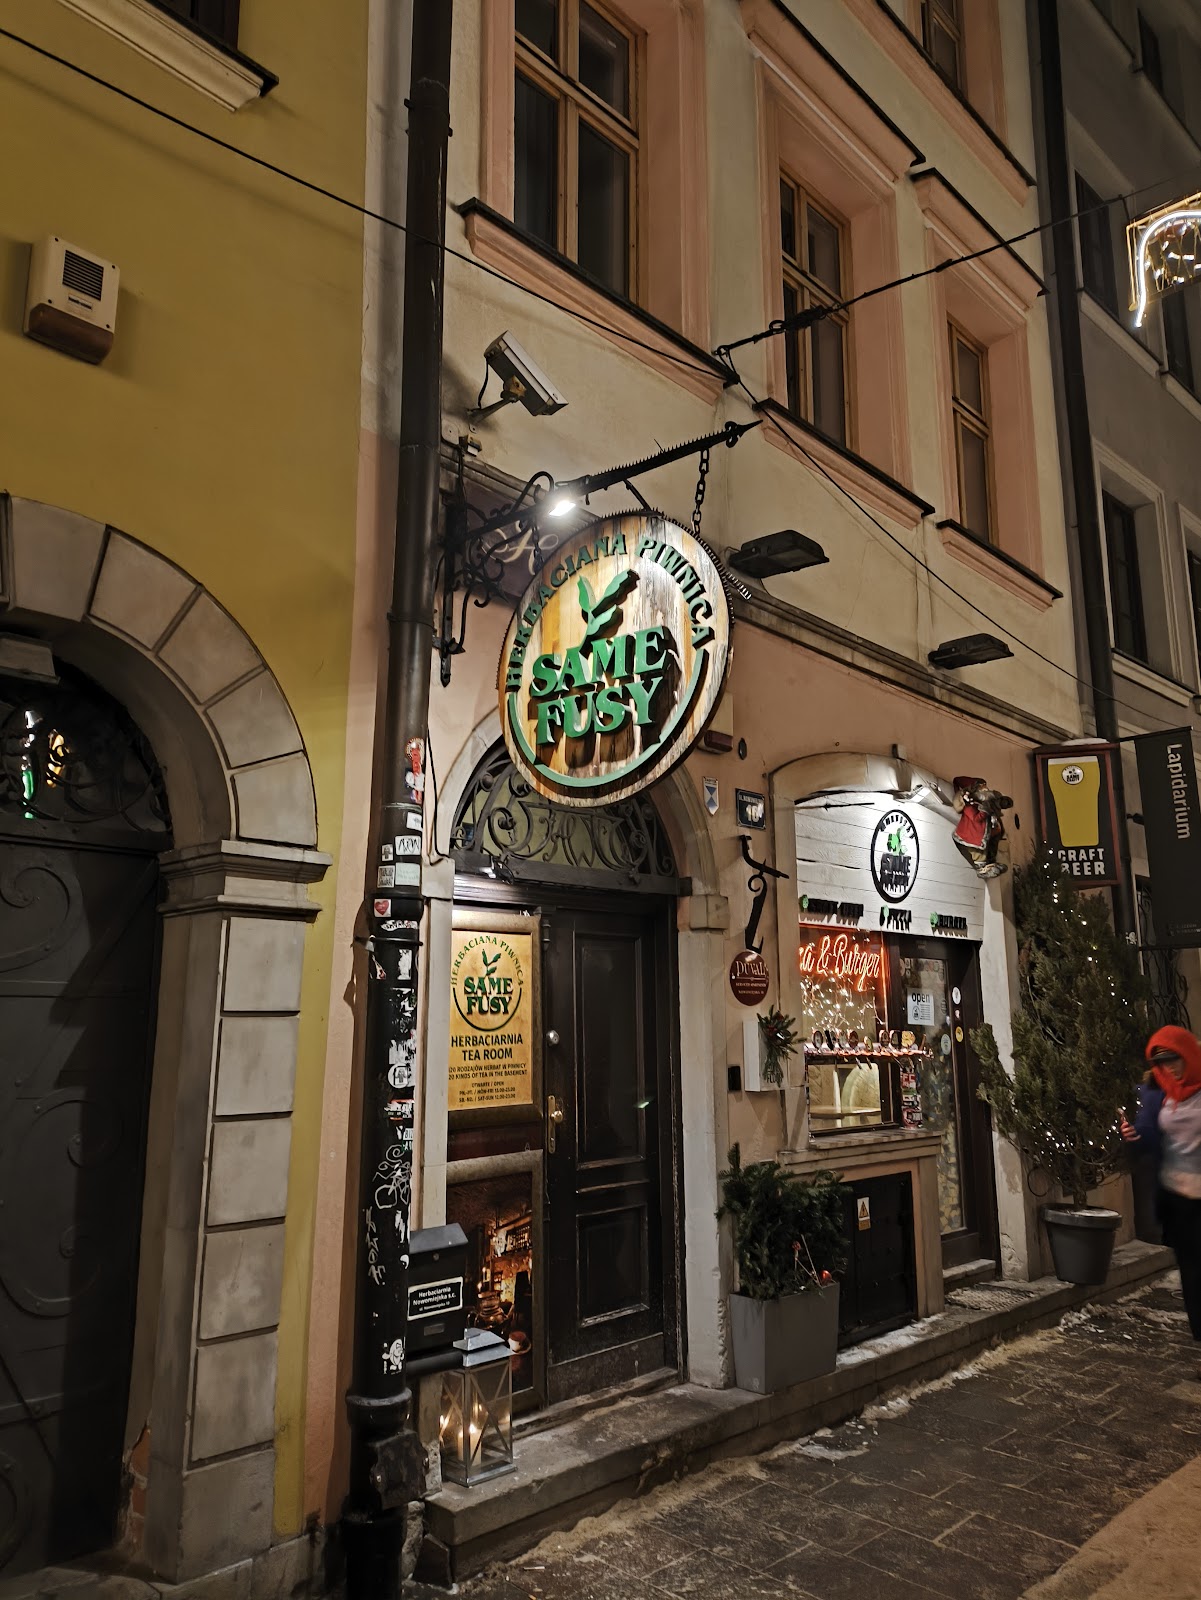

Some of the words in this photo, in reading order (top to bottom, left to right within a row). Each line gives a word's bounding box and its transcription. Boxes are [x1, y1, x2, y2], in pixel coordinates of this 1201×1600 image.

[505, 533, 628, 693] HERBACIANA
[634, 534, 715, 650] PIWNICA
[528, 625, 668, 697] SAME
[535, 677, 663, 745] FUSY
[1166, 743, 1191, 840] Lapidarium
[1057, 848, 1105, 861] CRAFT
[1061, 861, 1106, 876] BEER
[500, 941, 524, 986] PIWNICA
[817, 934, 831, 977] &
[833, 933, 880, 992] Burger
[464, 976, 513, 995] SAME
[467, 996, 512, 1015] FUSY
[911, 992, 931, 1005] open
[451, 1033, 524, 1048] HERBACIARNIA
[462, 1049, 481, 1061] TEA
[483, 1048, 513, 1060] ROOM
[412, 1294, 447, 1306] Nowomiejska
[418, 1286, 451, 1298] Herbaciarnia
